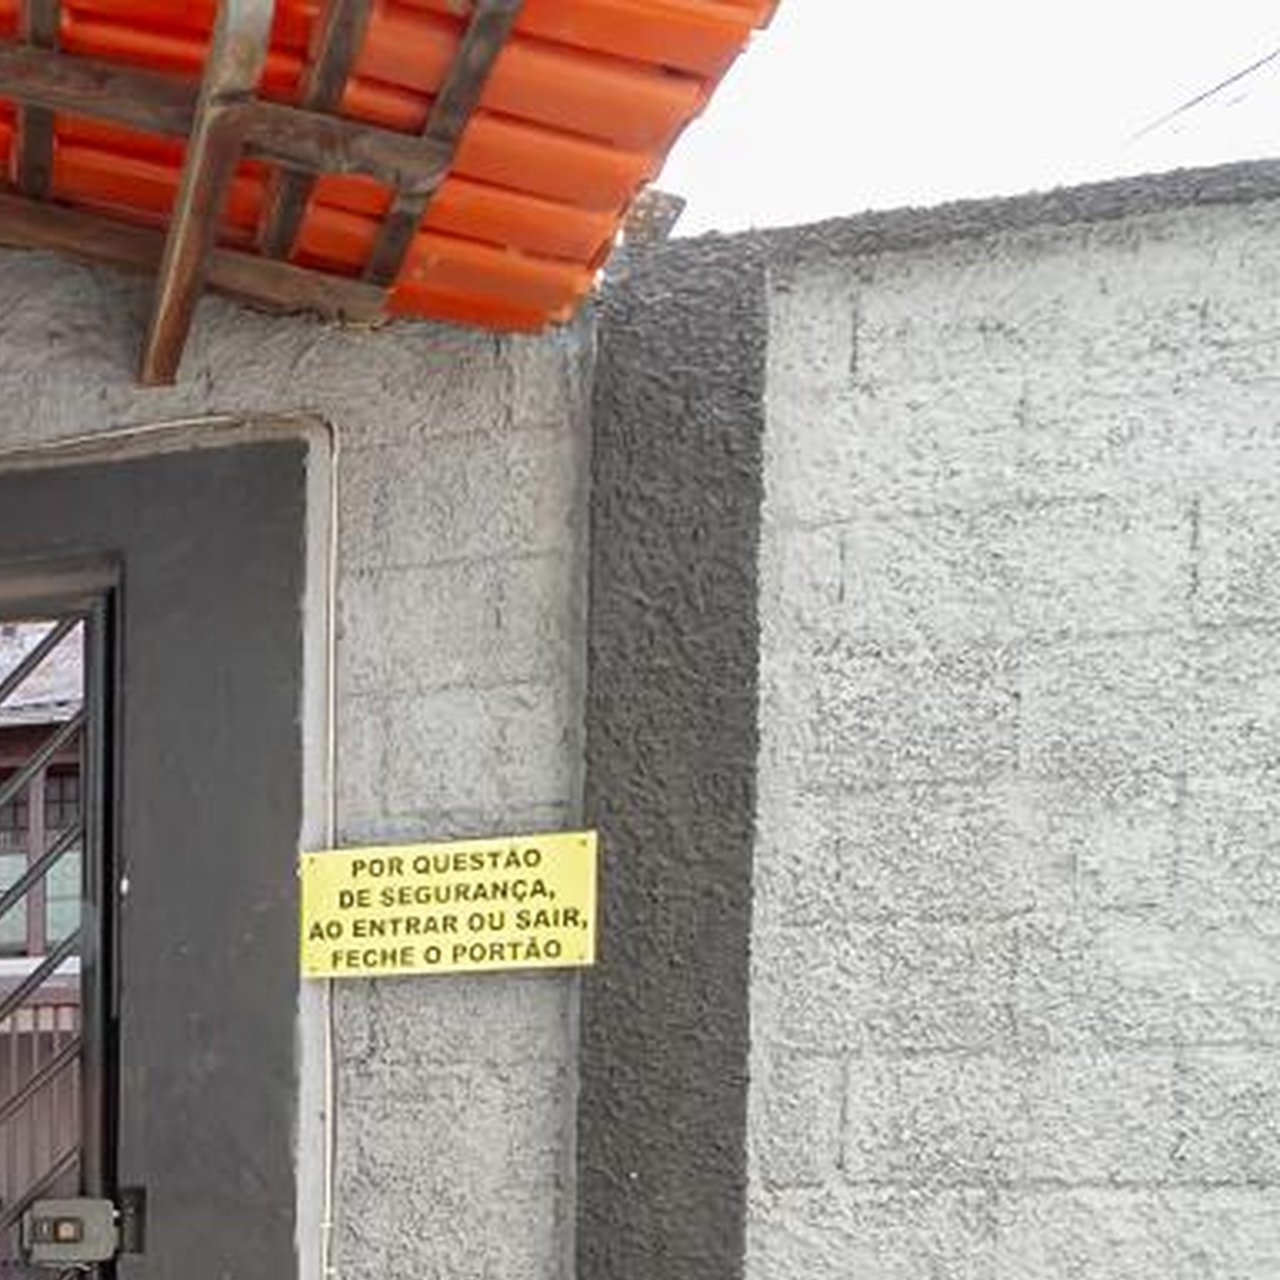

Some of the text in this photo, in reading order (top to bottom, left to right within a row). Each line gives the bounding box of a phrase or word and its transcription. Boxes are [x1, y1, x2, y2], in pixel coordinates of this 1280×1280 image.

[351, 859, 404, 878] POR
[339, 879, 556, 909] DE SEGURANÇA,
[308, 908, 588, 940] AO ENTRAR OU SAIR,
[331, 937, 562, 968] FECHE O PORTÃO
